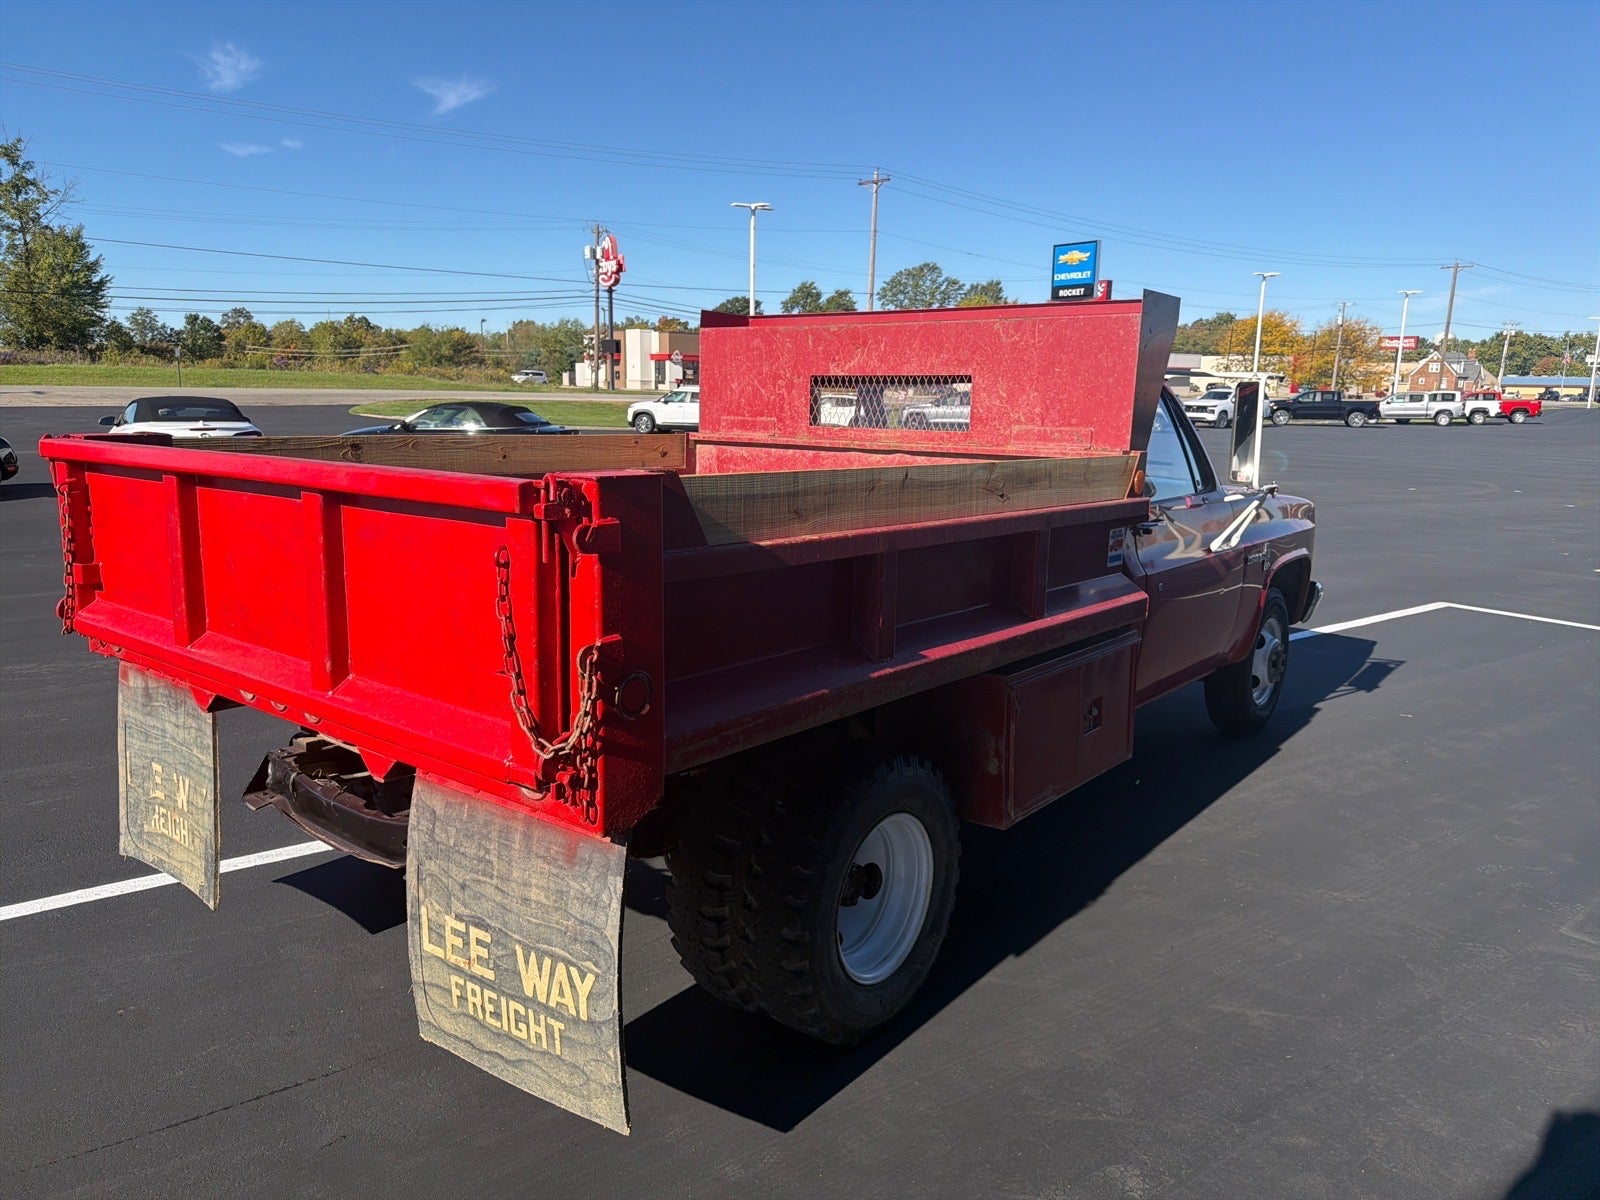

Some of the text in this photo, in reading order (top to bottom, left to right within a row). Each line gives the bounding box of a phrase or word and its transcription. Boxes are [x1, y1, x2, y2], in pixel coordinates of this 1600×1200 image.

[1054, 270, 1092, 281] CHEVROLET
[1058, 288, 1085, 297] ROCKET
[420, 904, 597, 1022] LEE WAY
[450, 974, 566, 1056] FREIGHT
